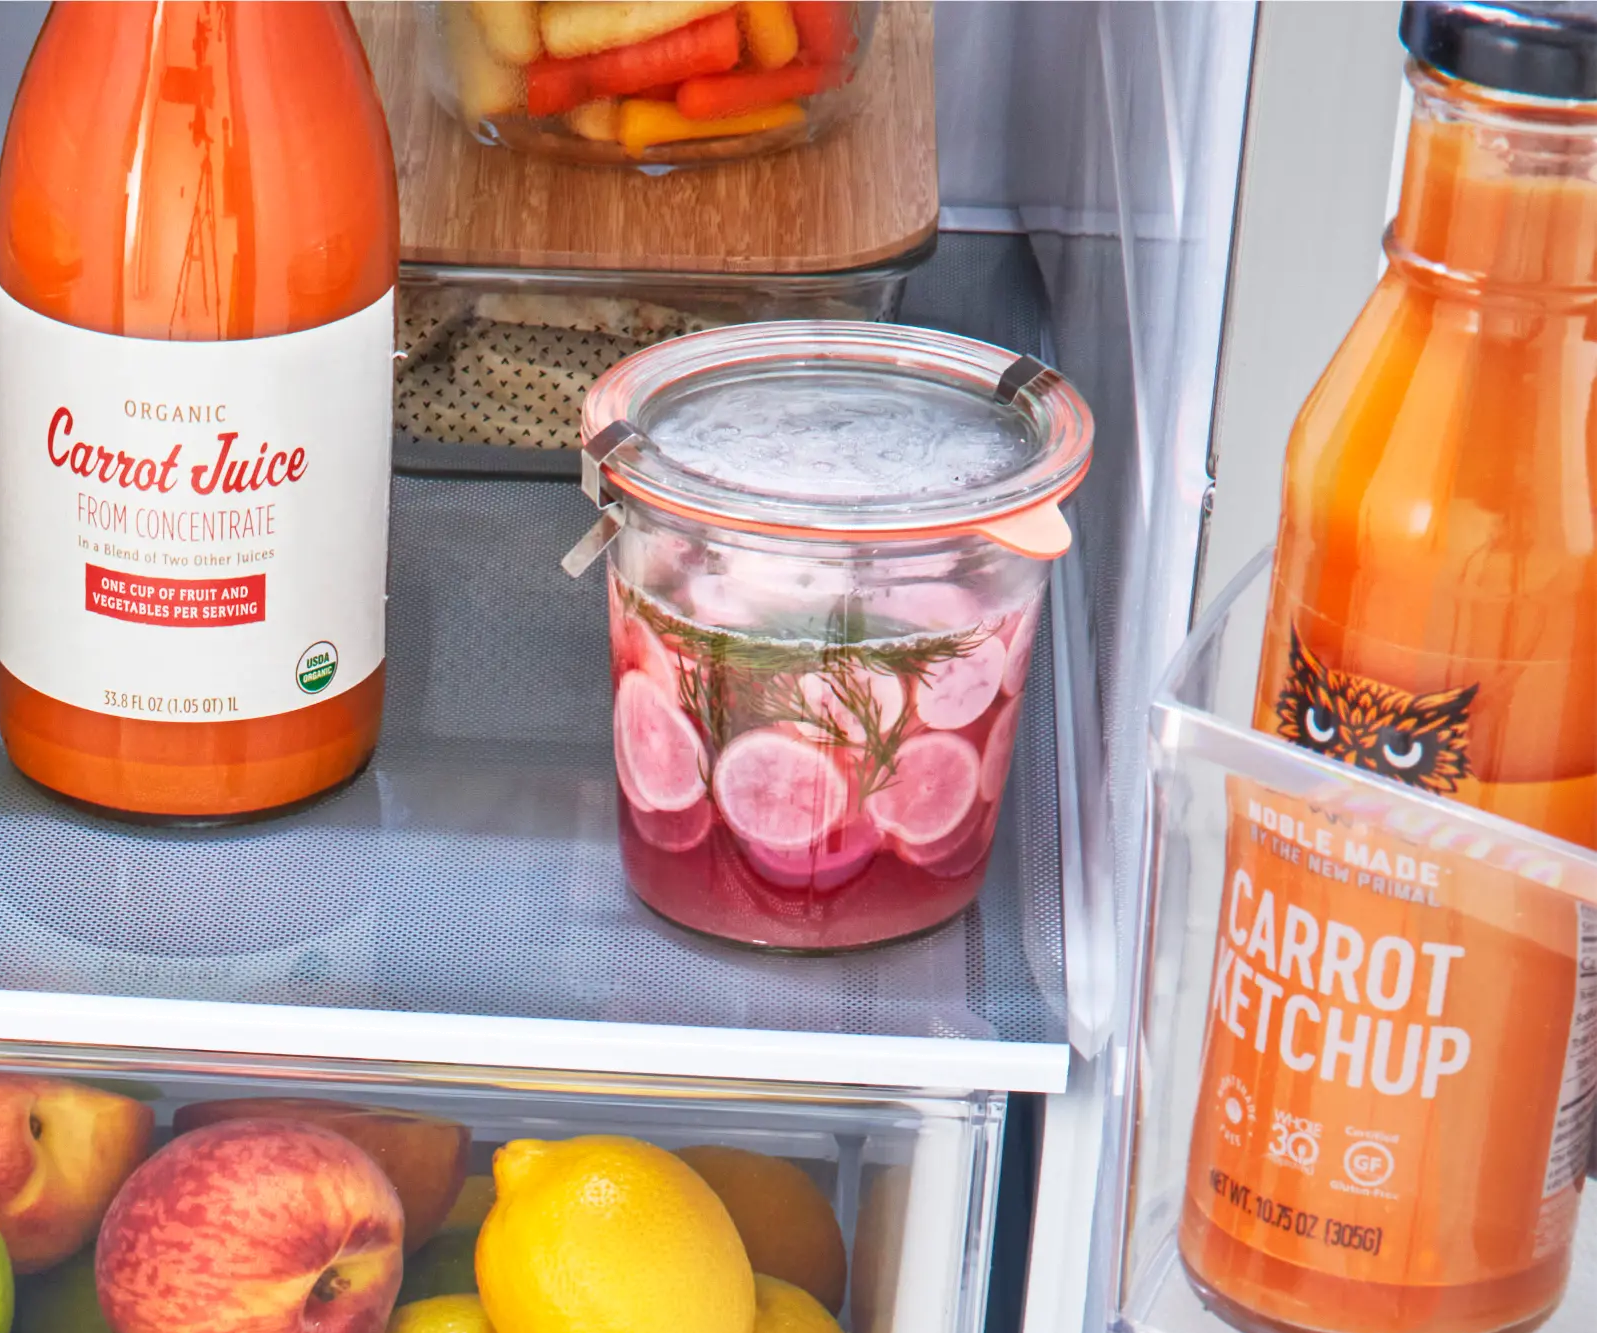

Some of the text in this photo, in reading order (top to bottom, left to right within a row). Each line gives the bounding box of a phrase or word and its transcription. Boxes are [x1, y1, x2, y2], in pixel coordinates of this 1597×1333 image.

[124, 399, 227, 423] ORGANIC
[47, 406, 309, 496] Carrot Juice
[77, 492, 276, 542] FROM CONCENTRATE
[78, 535, 275, 567] In a Blend of Two Other Juices
[92, 591, 258, 620] VEGETABLES PER SERVING
[101, 577, 249, 602] ONE CUP OF FRUIT AND
[302, 665, 333, 684] ORGANIC
[306, 651, 330, 669] USDA
[103, 689, 240, 715] 33.8 FL OZ (1.05 QT) 1L
[1247, 797, 1442, 888] NOBLE MADE
[1271, 834, 1302, 866] THE
[1308, 852, 1350, 883] NEW
[1357, 870, 1441, 908] PRIMAL
[1228, 867, 1466, 1018] CARROT
[1212, 933, 1472, 1100] KETCHUP
[1353, 1153, 1383, 1173] GF
[1229, 1179, 1252, 1215] WT.
[1255, 1196, 1293, 1233] 10.75
[1295, 1212, 1319, 1240] OZ
